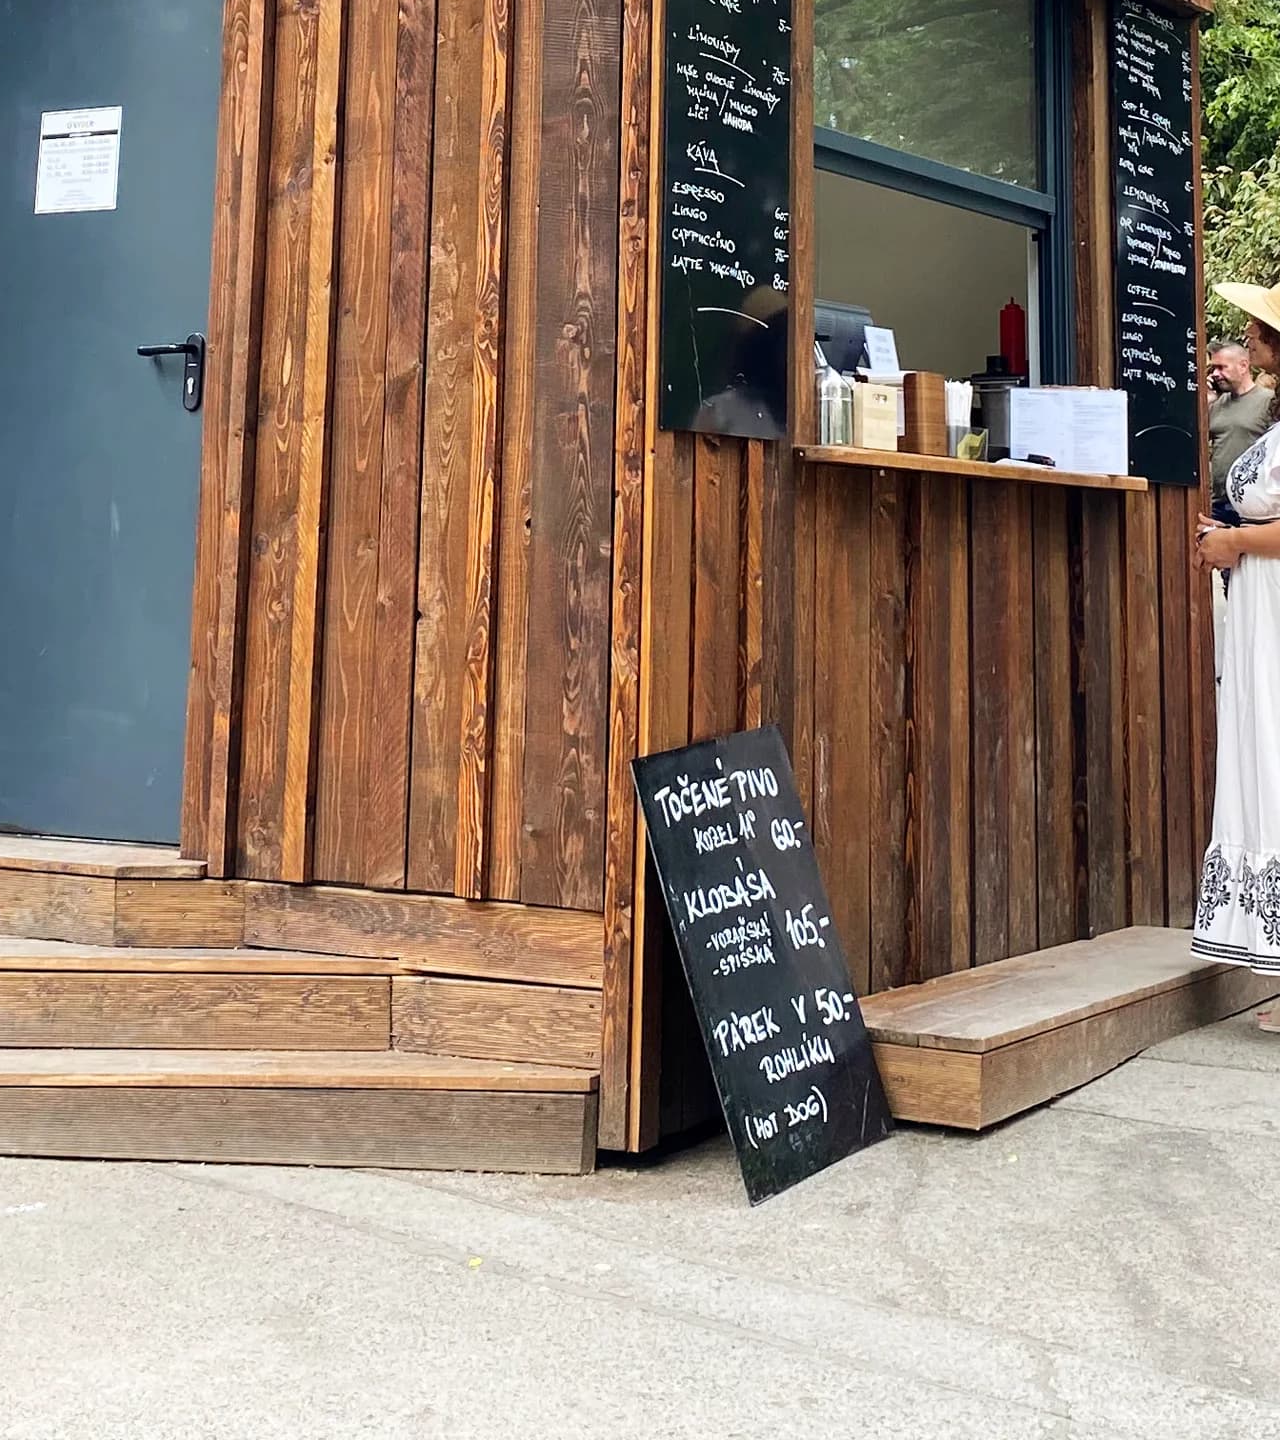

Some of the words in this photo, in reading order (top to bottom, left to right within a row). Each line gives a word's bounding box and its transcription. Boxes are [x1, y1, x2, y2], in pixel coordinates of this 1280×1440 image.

[687, 24, 740, 64] LIMONÁDY
[722, 112, 754, 133] JAHODA
[686, 140, 720, 173] KÁVA
[672, 181, 725, 204] ESPRESSO
[672, 203, 708, 221] LUNGO
[671, 228, 736, 253] CAPPUCCINO
[671, 254, 703, 275] LATTE
[1127, 283, 1159, 301] COFFEE
[654, 757, 732, 828] TOČENÉ
[730, 767, 779, 802] PIVO
[693, 822, 739, 855] KOZEL
[683, 856, 777, 924] KLOBÁSA
[713, 1006, 781, 1057] PÁREK
[791, 995, 807, 1024] V
[759, 1032, 836, 1084] ROHLÍKU
